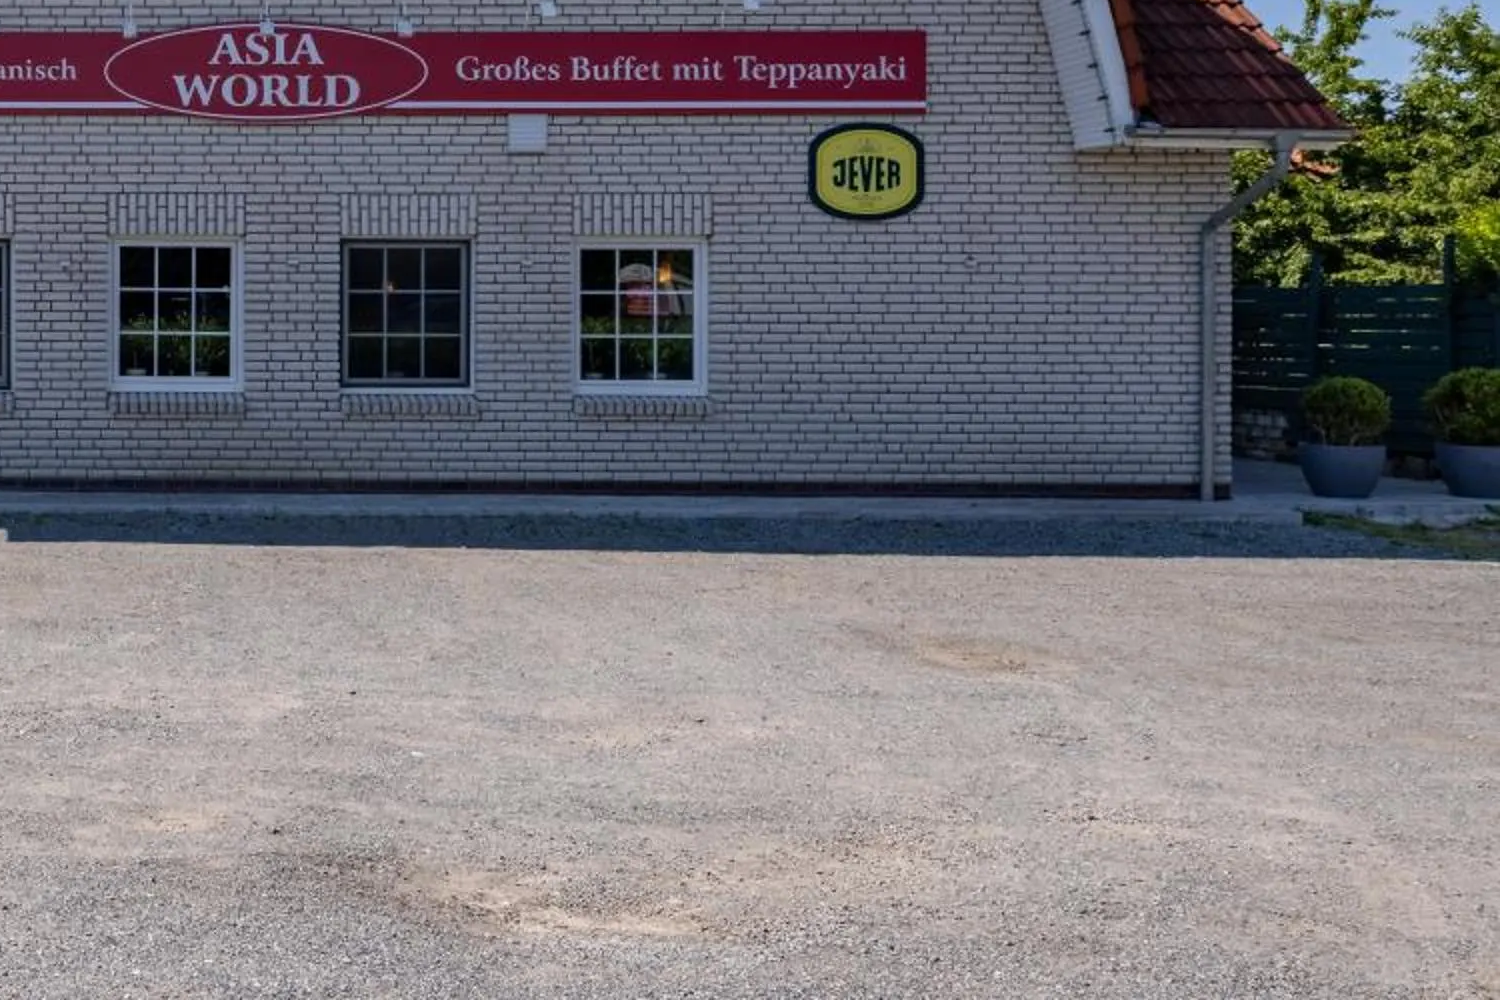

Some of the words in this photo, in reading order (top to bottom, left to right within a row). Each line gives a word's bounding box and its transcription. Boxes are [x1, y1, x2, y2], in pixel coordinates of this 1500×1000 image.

[208, 31, 324, 65] ASIA
[455, 55, 560, 81] Großes
[569, 55, 663, 81] Buffet
[672, 57, 723, 81] mit
[733, 55, 906, 89] Teppanyaki
[173, 73, 360, 107] WORLD
[832, 155, 901, 192] JEVER
